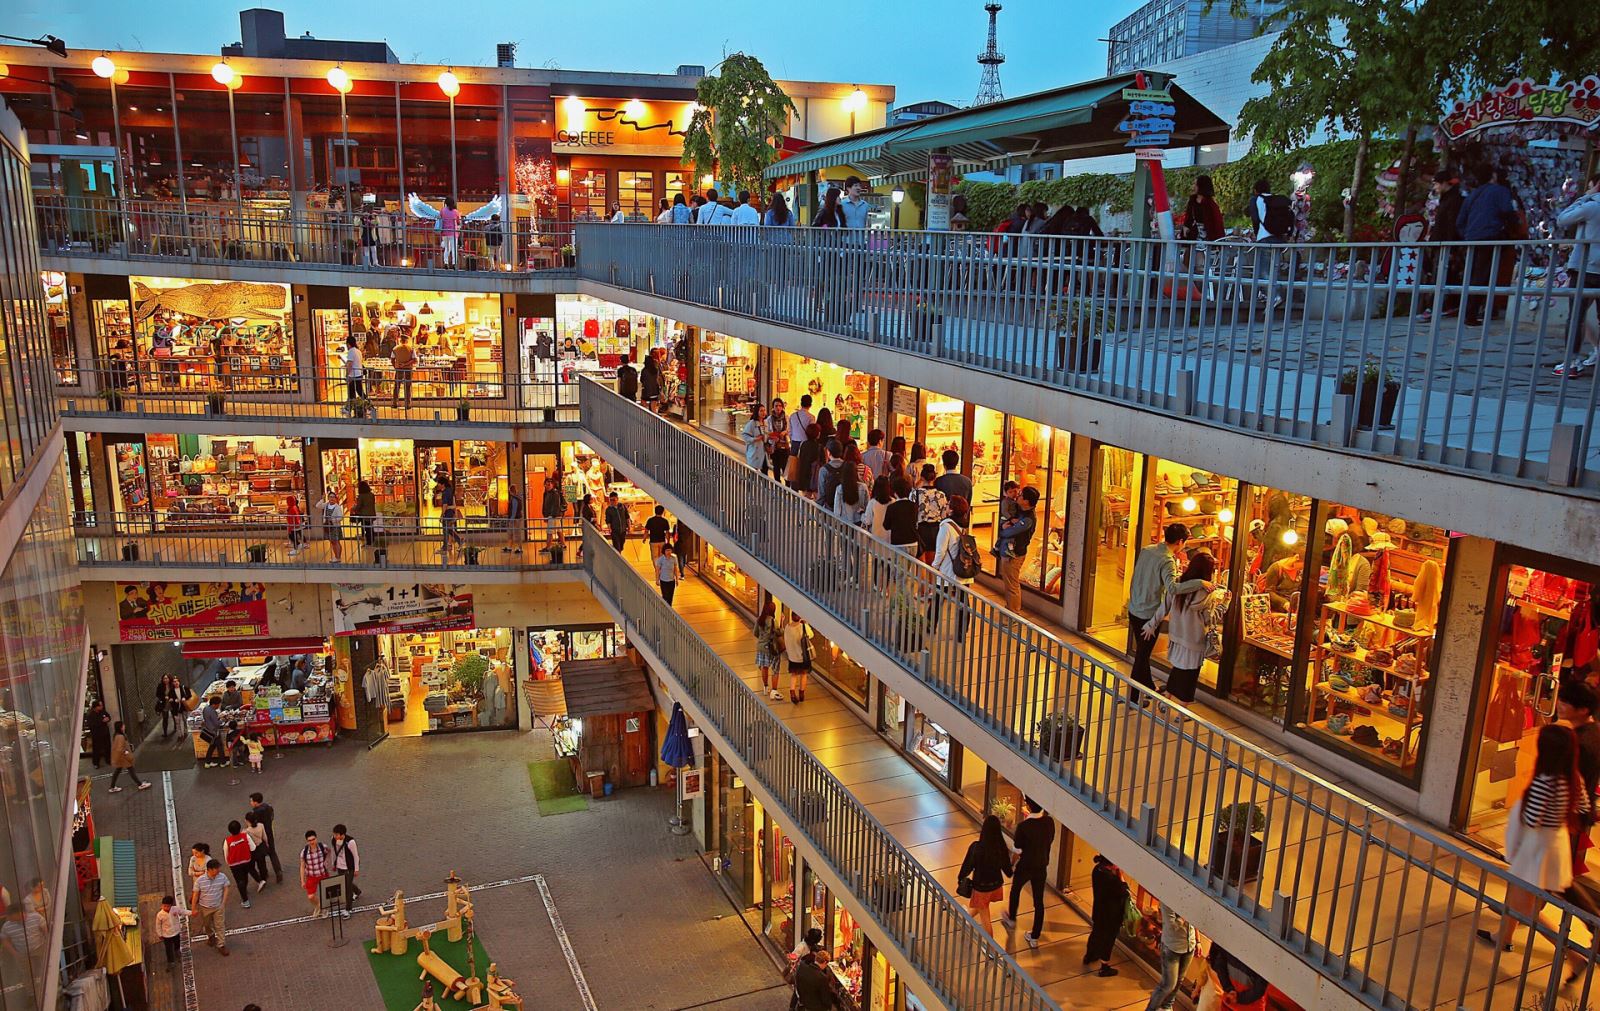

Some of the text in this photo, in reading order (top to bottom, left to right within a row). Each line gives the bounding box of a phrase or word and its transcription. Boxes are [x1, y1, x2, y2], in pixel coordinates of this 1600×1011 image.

[1463, 89, 1570, 121] 사랑의 담장
[557, 129, 614, 145] COFFEE
[148, 594, 218, 625] 쉬어매드니스
[146, 628, 176, 640] 이벤트
